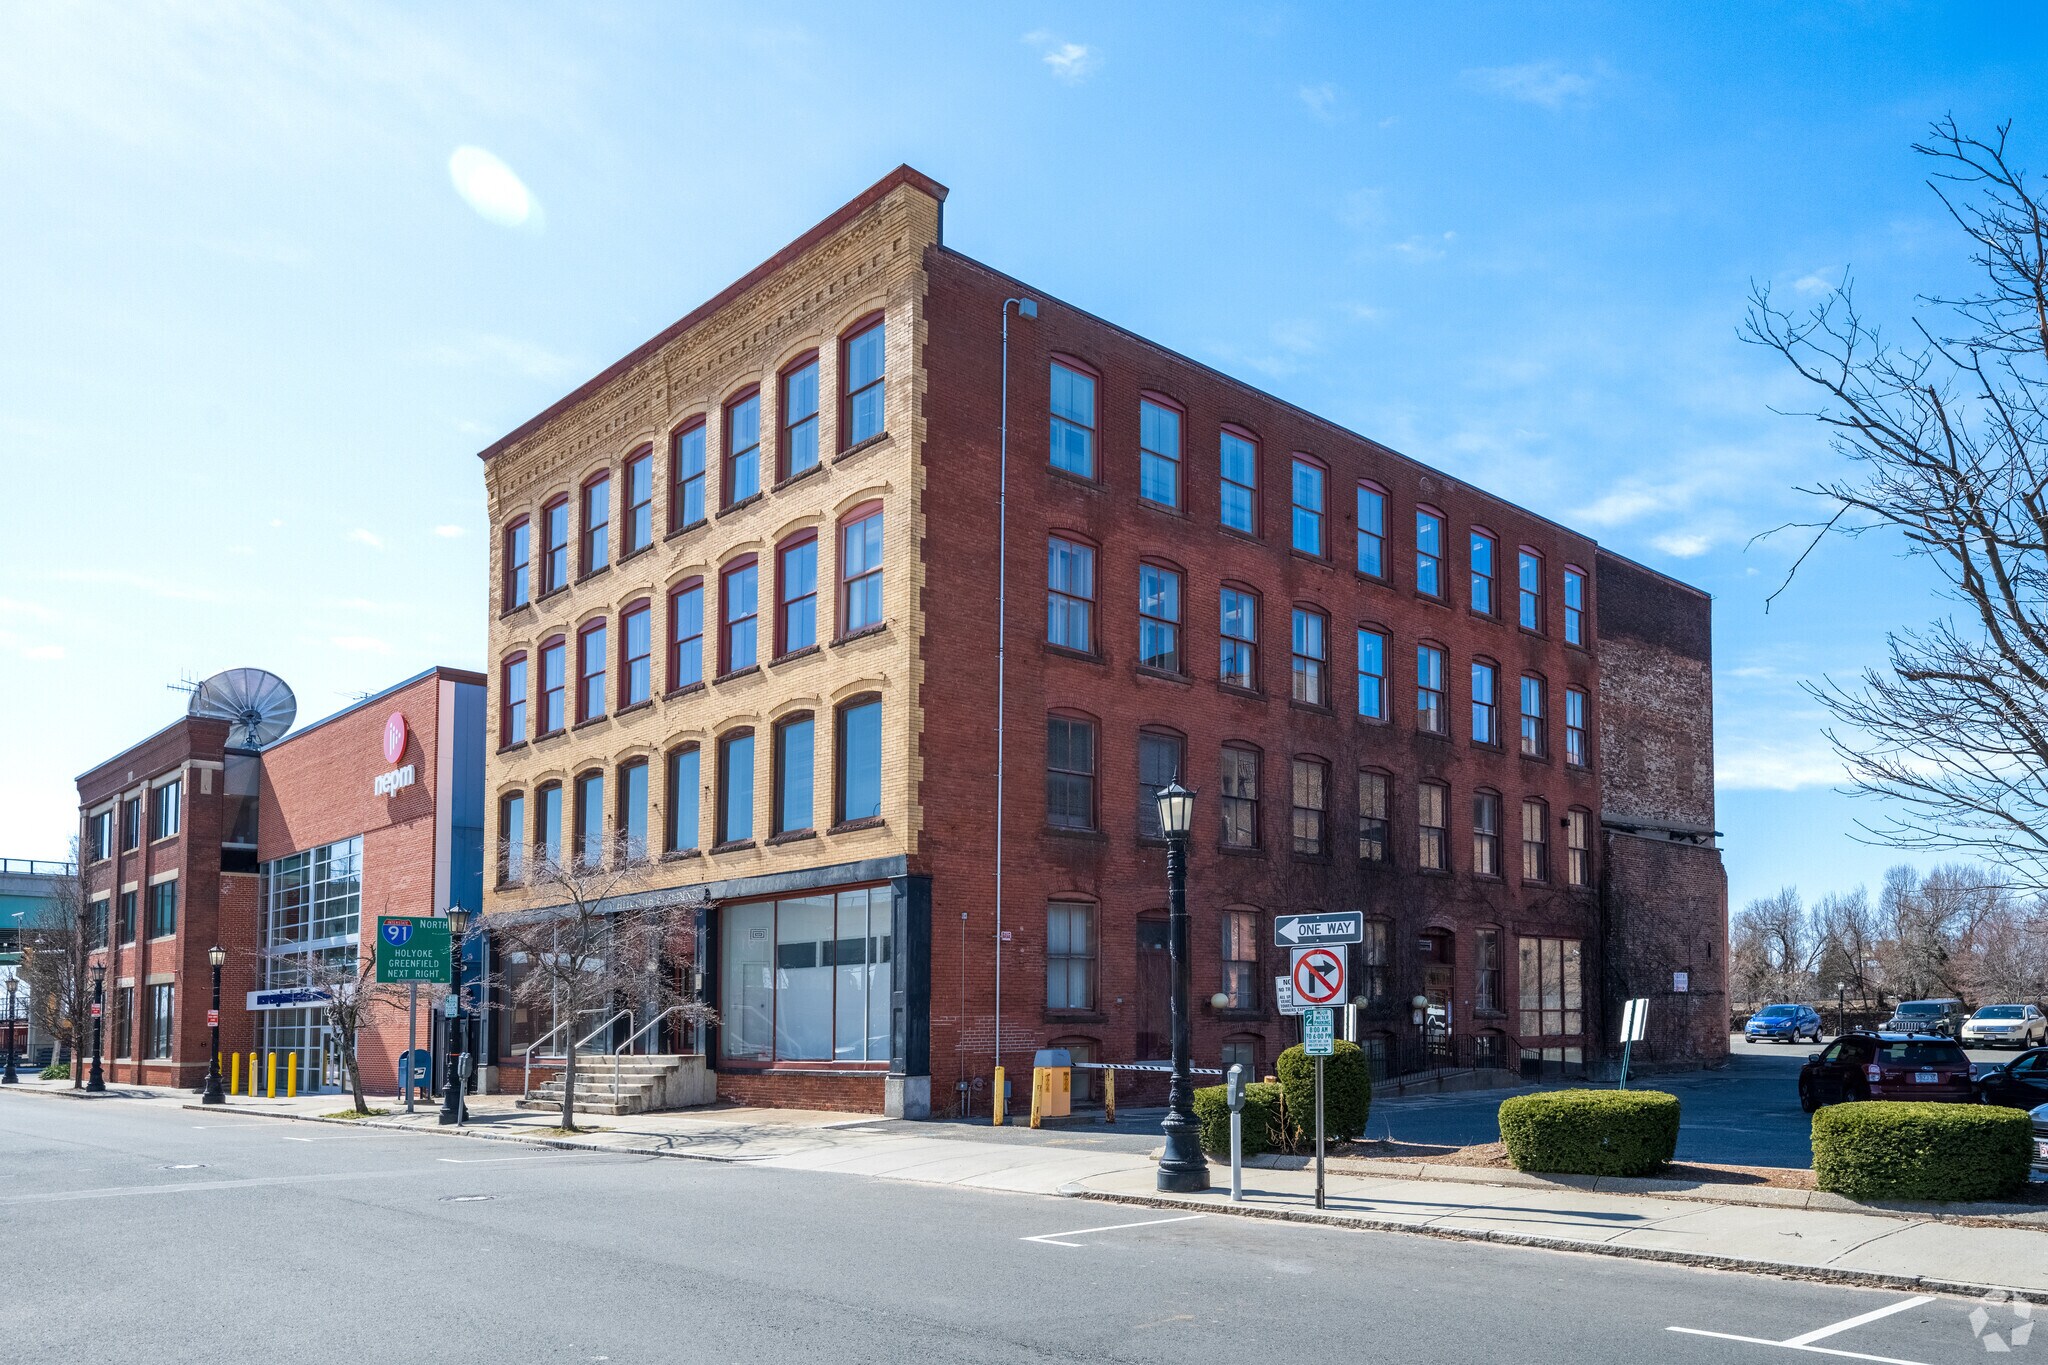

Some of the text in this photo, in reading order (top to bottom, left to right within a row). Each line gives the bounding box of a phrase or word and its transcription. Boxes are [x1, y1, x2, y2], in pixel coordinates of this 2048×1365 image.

[375, 764, 415, 797] nepm
[420, 920, 448, 929] NORTH
[1299, 922, 1351, 935] ONE WAY
[388, 926, 406, 941] 91
[395, 949, 433, 958] HOLYOKE
[389, 960, 439, 968] GREENFIELD
[388, 970, 440, 978] NEXT RIGHT
[1306, 1014, 1313, 1026] 2
